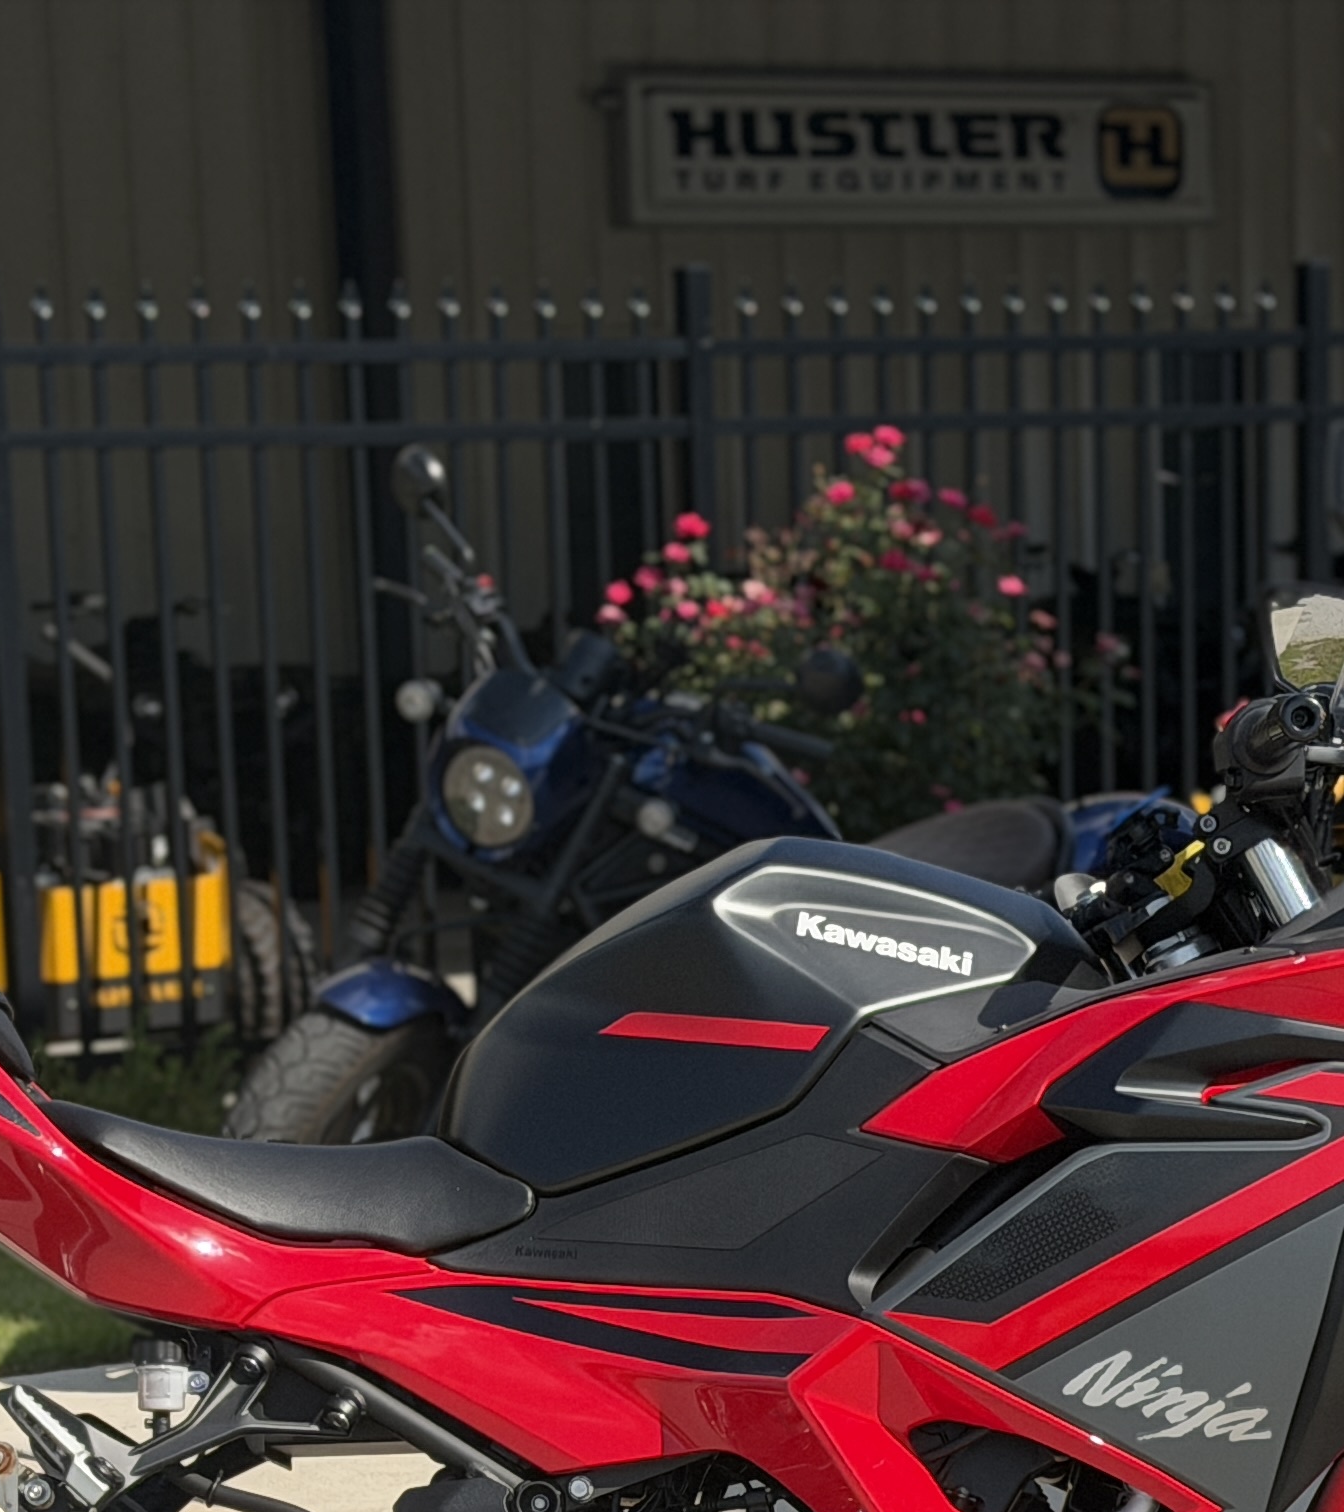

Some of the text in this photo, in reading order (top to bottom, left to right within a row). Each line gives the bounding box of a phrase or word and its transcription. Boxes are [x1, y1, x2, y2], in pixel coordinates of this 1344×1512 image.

[668, 108, 1067, 161] HUSTLER
[674, 168, 1069, 194] TURF EQUIPMENT
[795, 910, 974, 977] Kawasaki
[1062, 1350, 1273, 1442] Ninja
